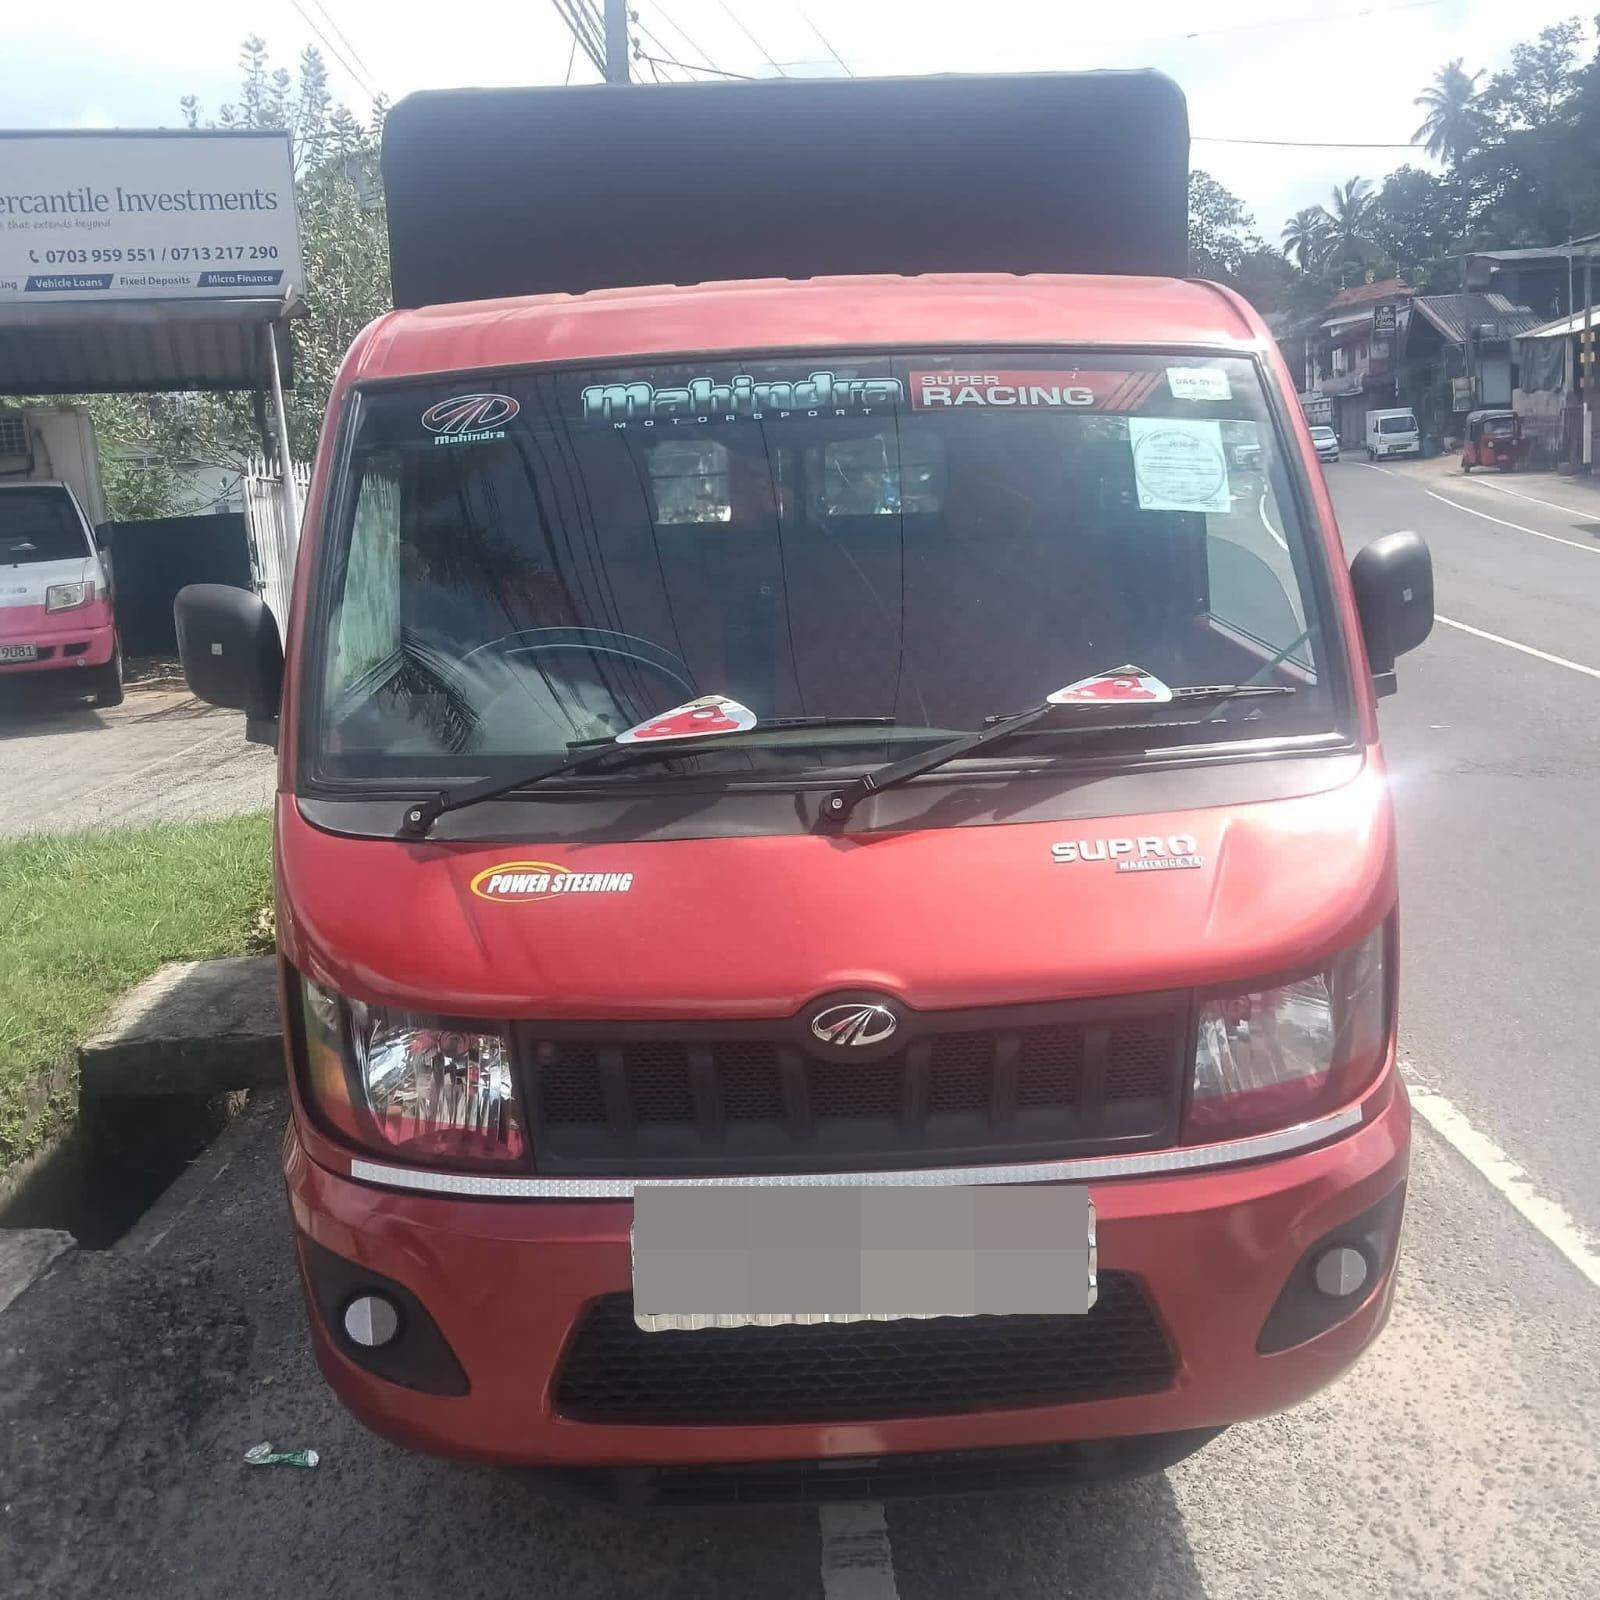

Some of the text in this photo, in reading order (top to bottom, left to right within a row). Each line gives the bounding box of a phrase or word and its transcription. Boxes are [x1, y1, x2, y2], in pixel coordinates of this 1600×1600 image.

[116, 187, 278, 213] Investments
[46, 246, 279, 263] 0703 959 551 / 0713 217 290
[0, 273, 274, 291] ing Vehicle Loans Fixed Deposits Micro Finance
[921, 375, 1000, 386] SUPER
[581, 371, 904, 420] Mahindra
[922, 386, 1095, 407] RACING
[613, 407, 874, 430] MOTORSPORT
[434, 431, 505, 446] Mahindra
[2, 647, 35, 658] 9081
[1051, 833, 1198, 863] SUPRO
[486, 872, 634, 894] POWER STEERING
